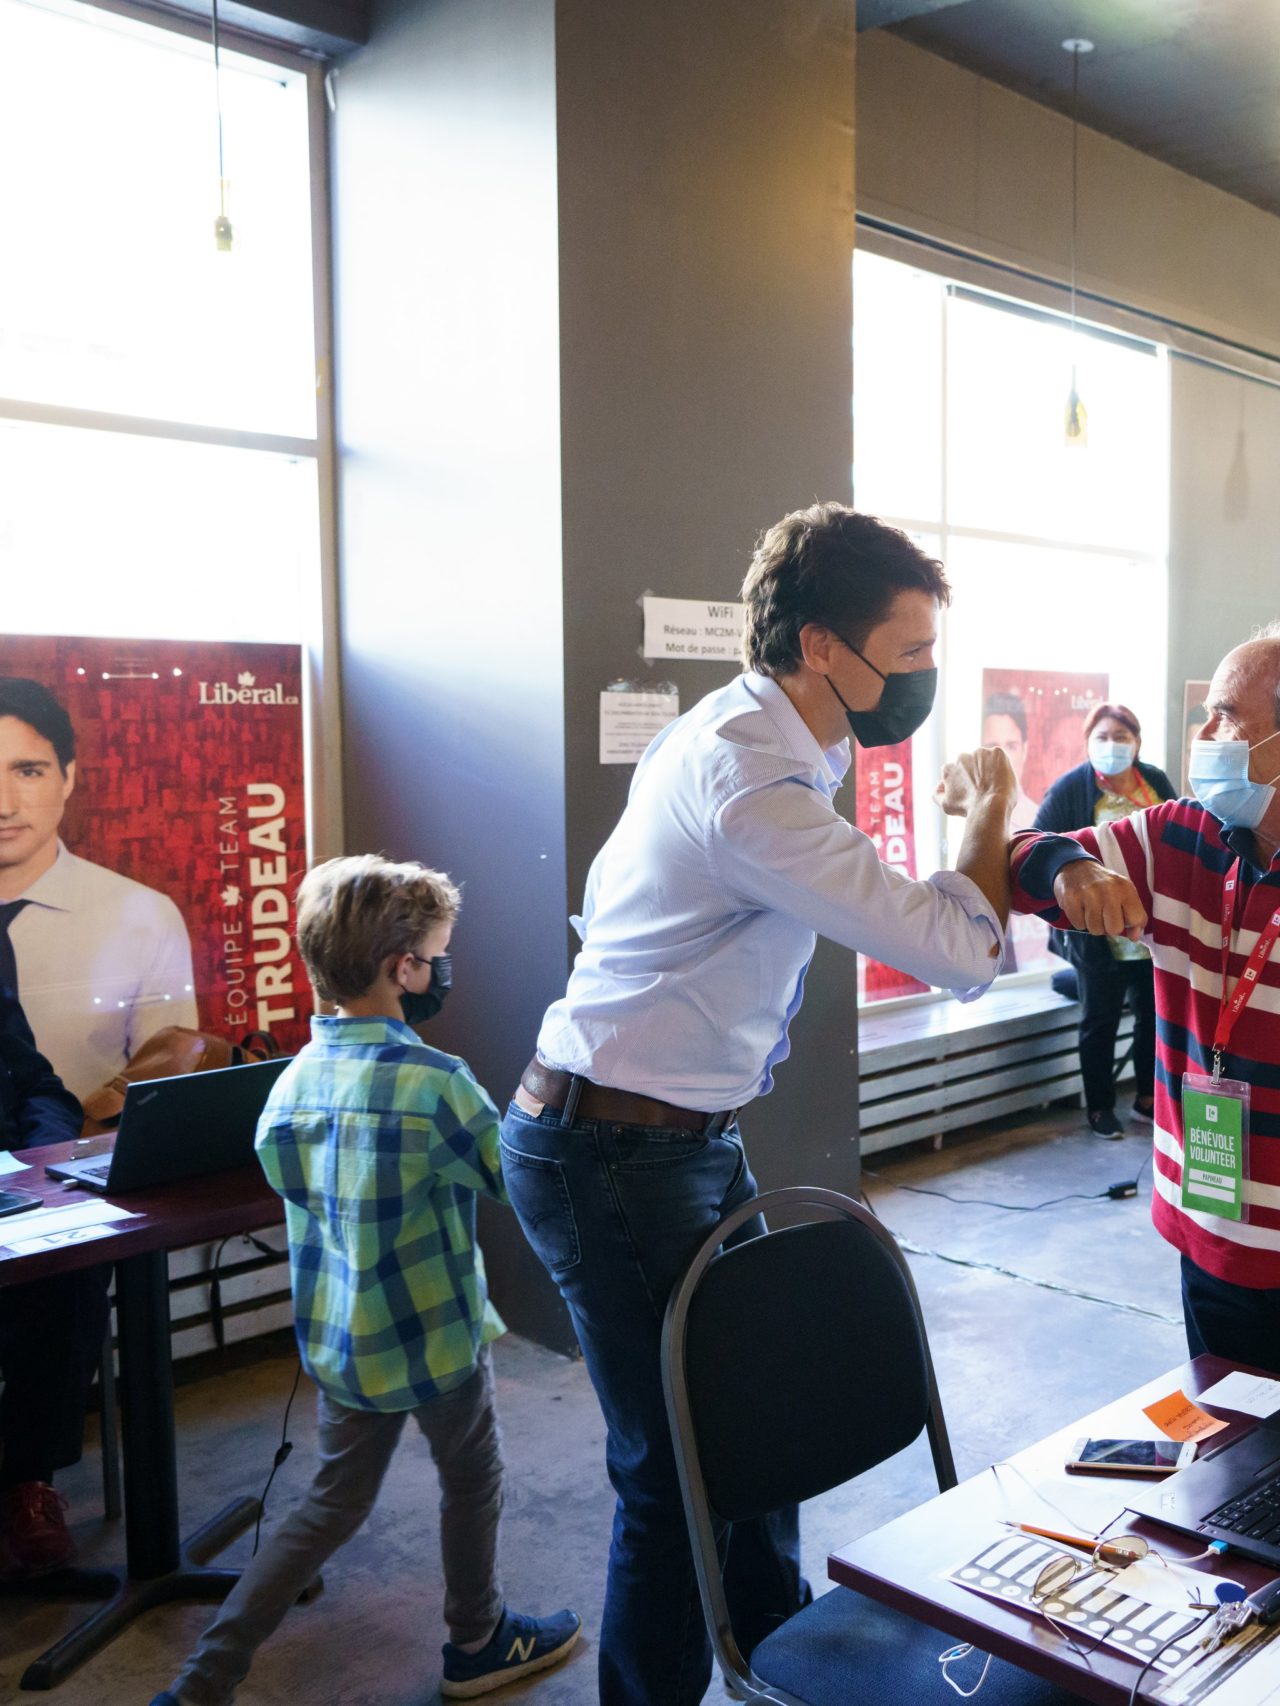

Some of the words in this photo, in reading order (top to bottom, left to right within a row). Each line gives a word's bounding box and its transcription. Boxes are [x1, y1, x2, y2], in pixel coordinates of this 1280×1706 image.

[707, 606, 734, 618] WiFi
[663, 624, 697, 636] Réseau
[665, 642, 685, 653] Mot
[687, 644, 698, 653] de
[701, 647, 726, 655] passe
[869, 771, 881, 826] TEAM
[219, 796, 240, 874] TEAM
[247, 783, 295, 1034] TRUDEAU
[223, 921, 248, 1026] ÉQUIPE
[1190, 1127, 1235, 1152] BÉNÉVOLE
[1190, 1145, 1236, 1169] VOLUNTEER
